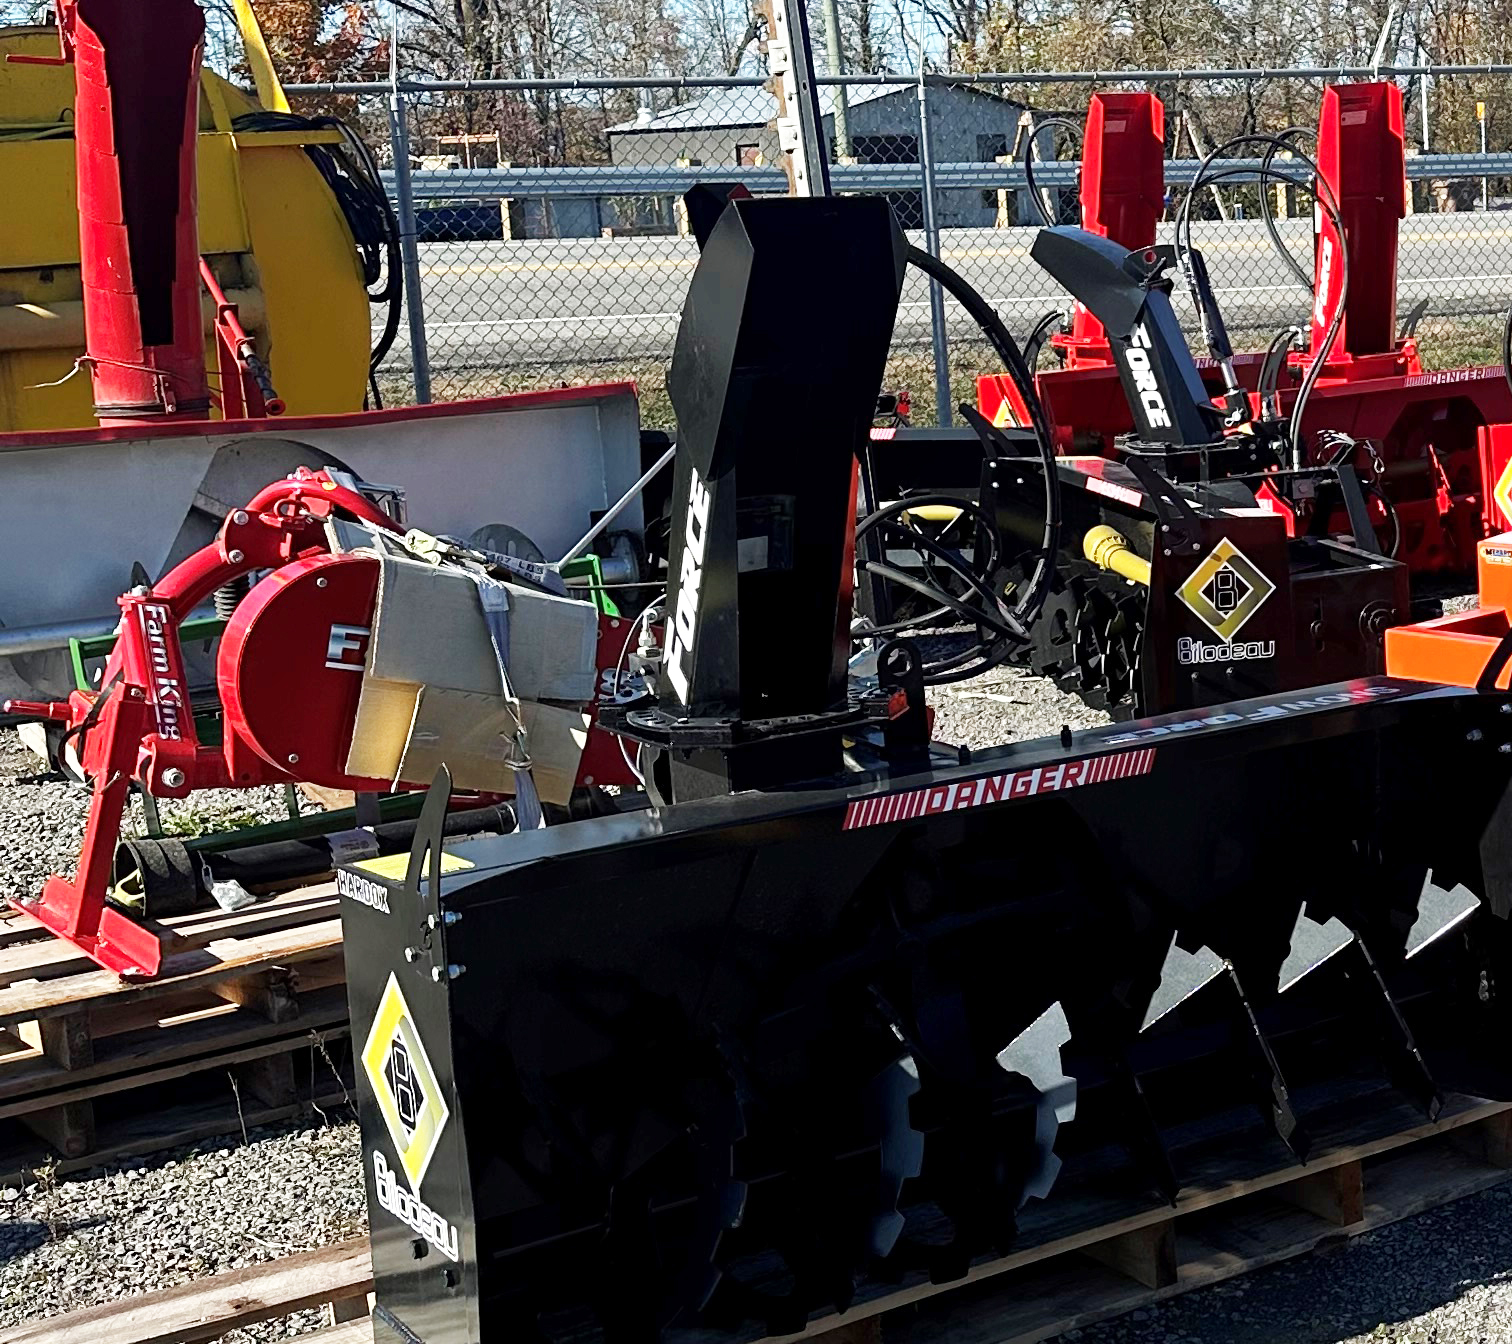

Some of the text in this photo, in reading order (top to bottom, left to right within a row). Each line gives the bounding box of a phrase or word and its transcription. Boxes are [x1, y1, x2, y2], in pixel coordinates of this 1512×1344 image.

[1124, 322, 1172, 429] FORCE
[1430, 369, 1486, 385] DANGER
[662, 467, 711, 707] FORCE
[144, 605, 183, 742] Farm King
[1178, 636, 1275, 665] Bilodeau
[924, 759, 1088, 814] DANGER
[338, 868, 391, 915] HARDOX
